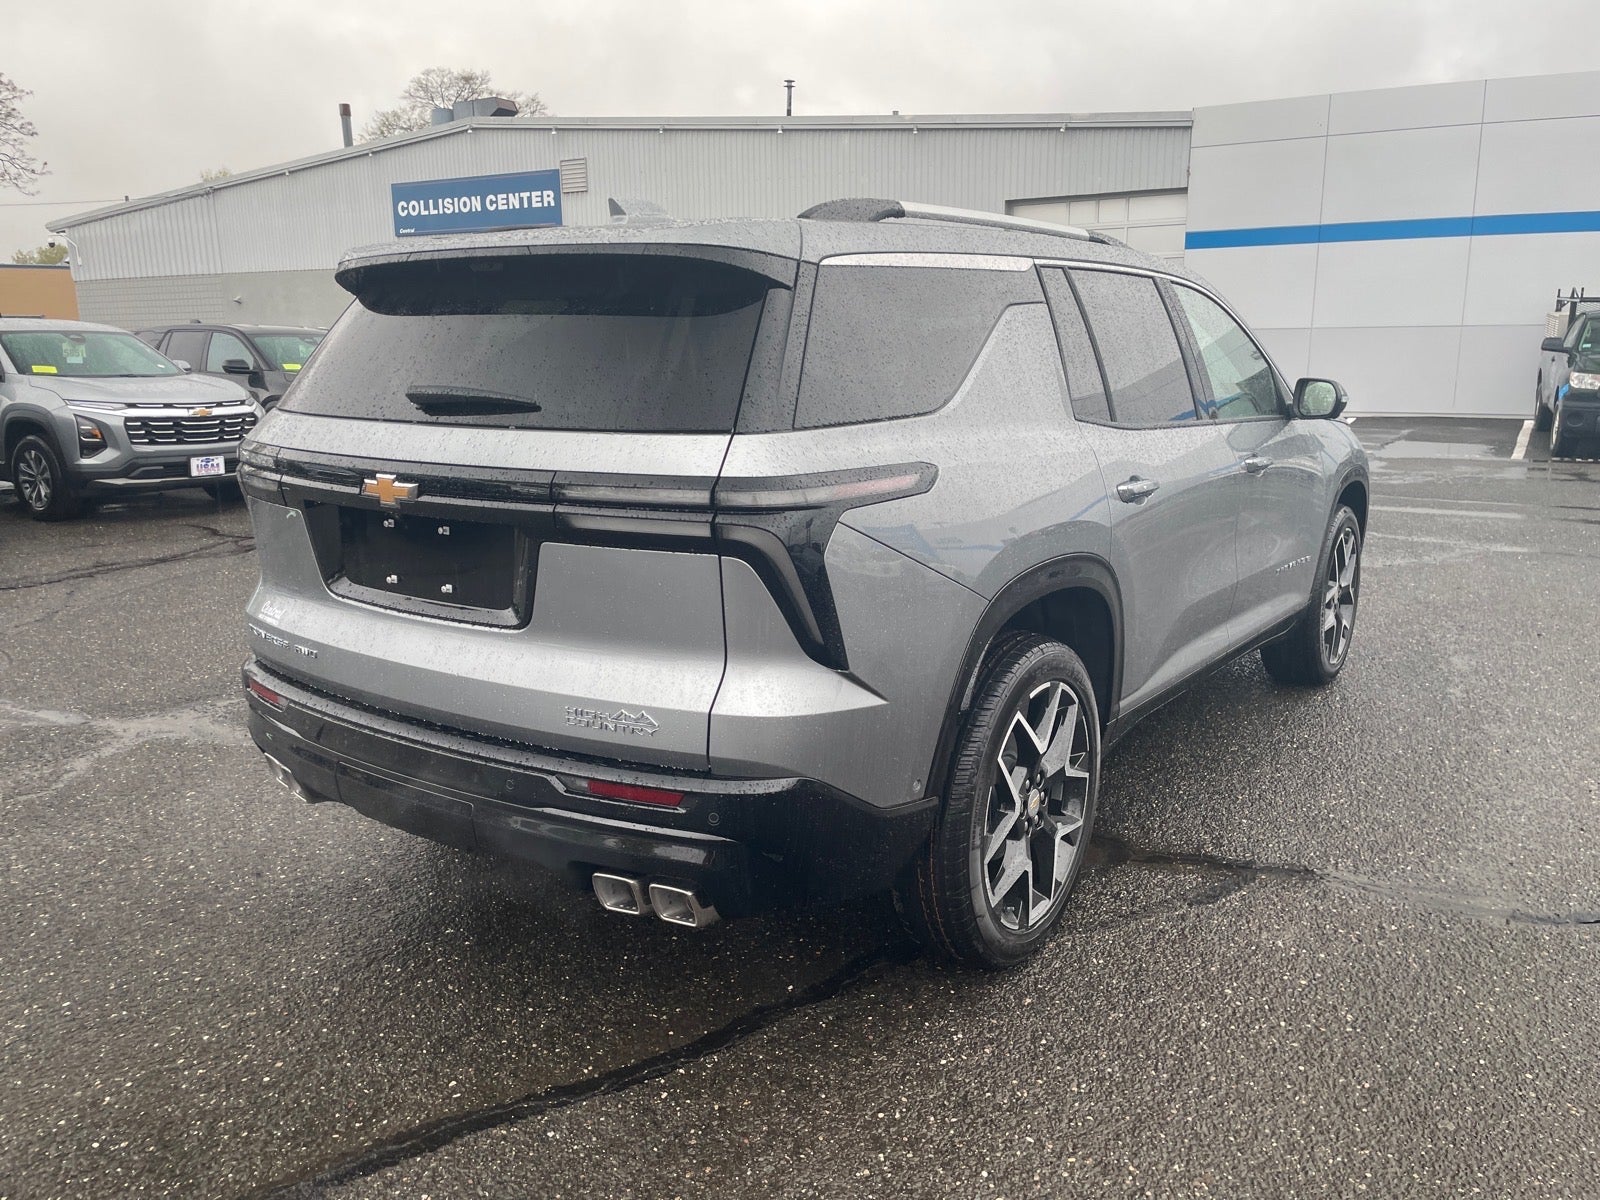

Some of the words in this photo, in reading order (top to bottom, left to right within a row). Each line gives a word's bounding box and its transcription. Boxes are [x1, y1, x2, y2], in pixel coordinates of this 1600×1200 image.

[397, 196, 481, 217] COLLISION
[485, 190, 555, 211] CENTER
[565, 706, 611, 720] HIGH
[565, 716, 660, 737] COUNTRY
